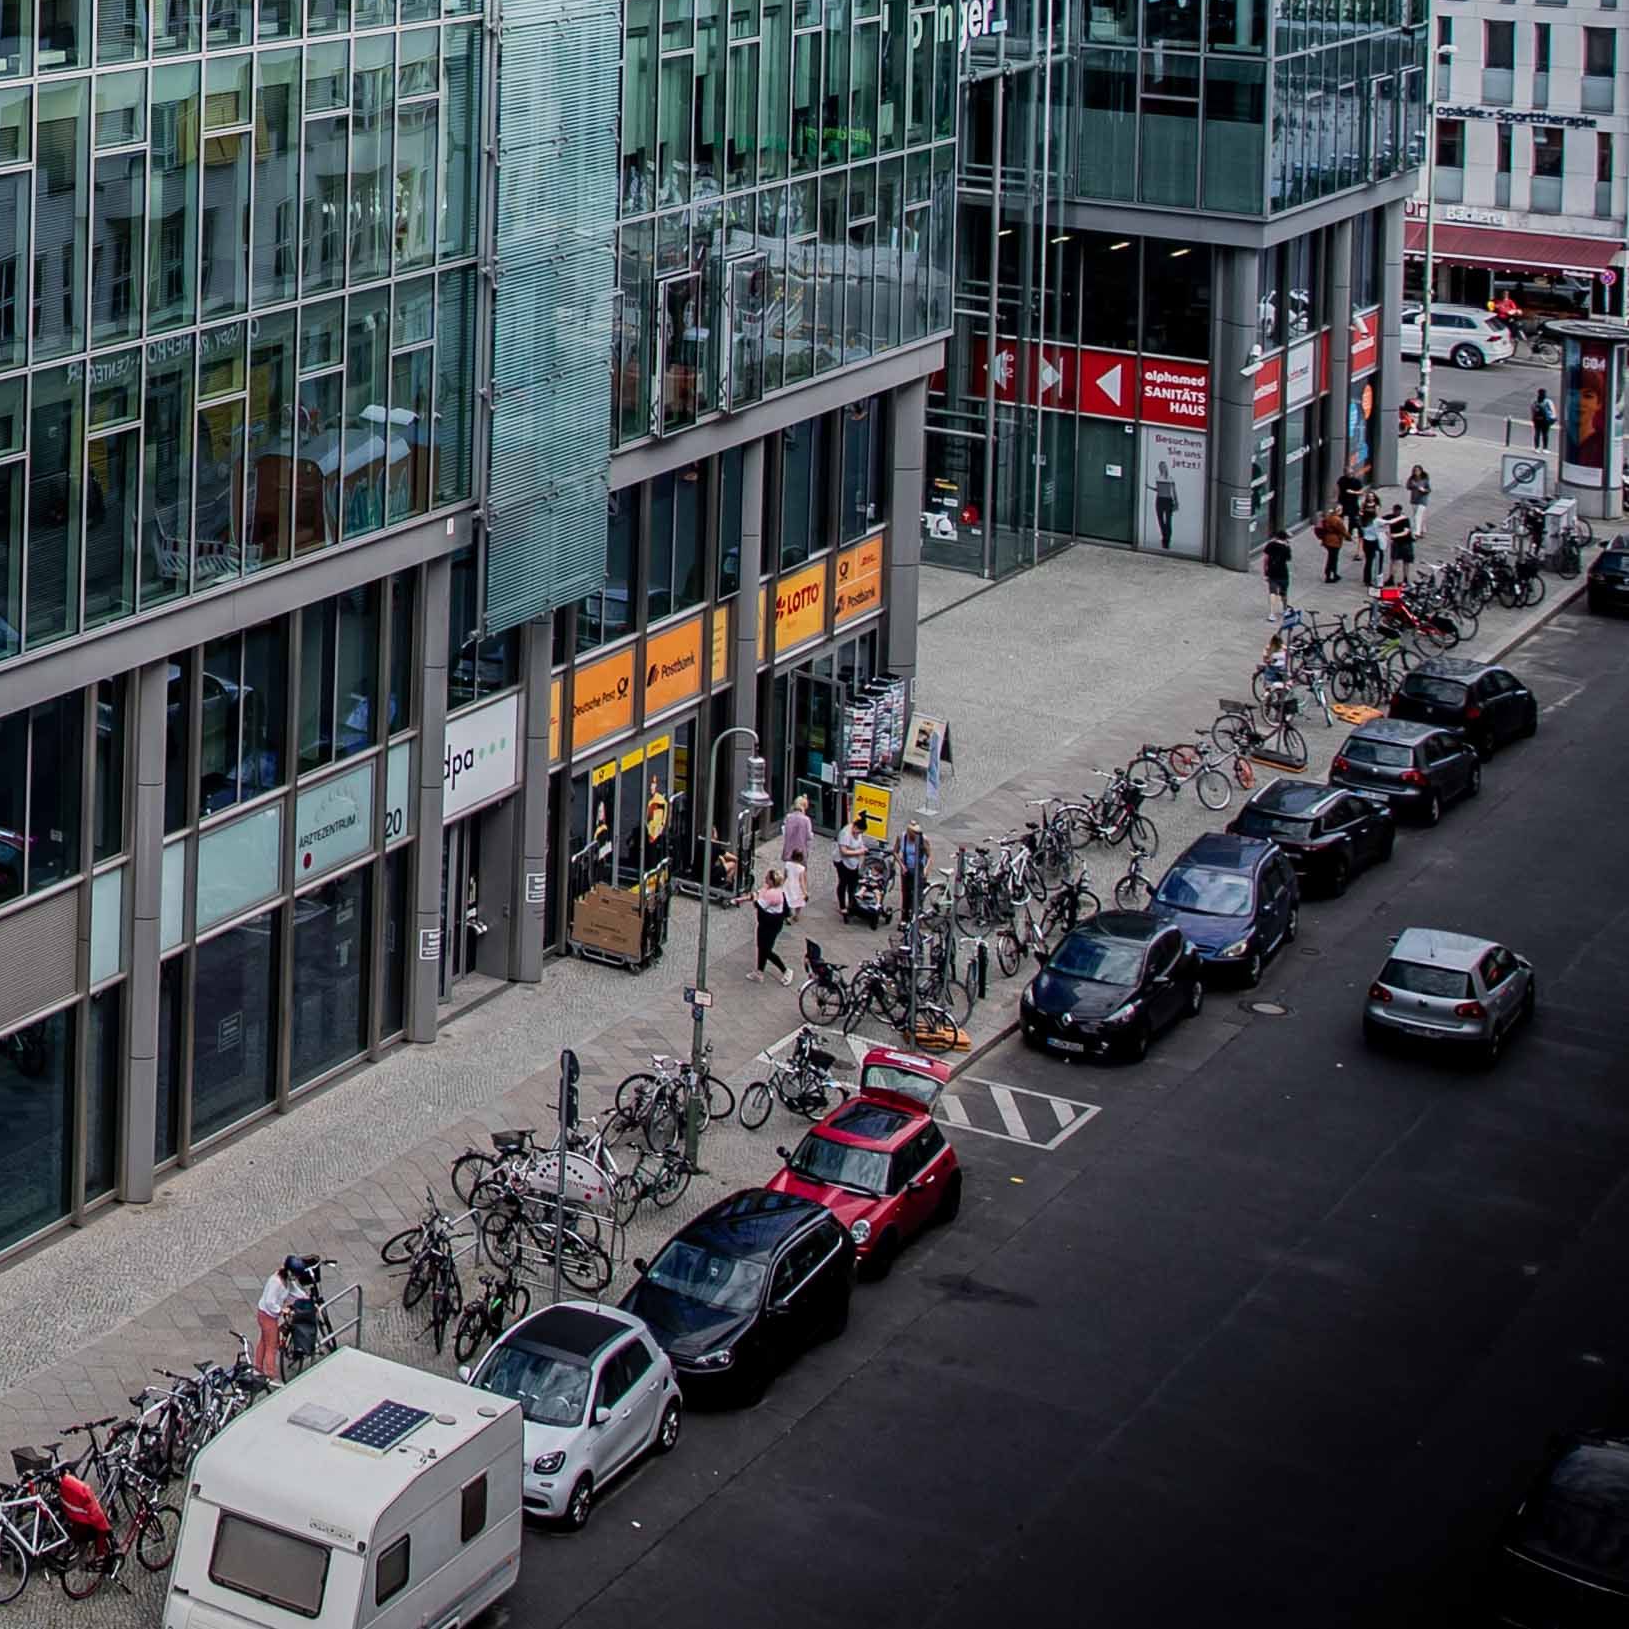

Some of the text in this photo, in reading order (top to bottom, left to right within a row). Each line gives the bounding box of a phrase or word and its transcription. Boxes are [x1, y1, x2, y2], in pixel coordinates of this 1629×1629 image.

[1144, 370, 1206, 387] alphamed
[1144, 385, 1206, 404] SANITÄTS
[1169, 402, 1206, 417] HAUS
[1155, 434, 1203, 449] Besuchen
[1167, 445, 1202, 459] Sie uns
[1171, 458, 1201, 470] jetzt!
[787, 583, 820, 615] LOTTO
[661, 651, 696, 681] Postbank
[573, 689, 616, 719] Deutsche Post
